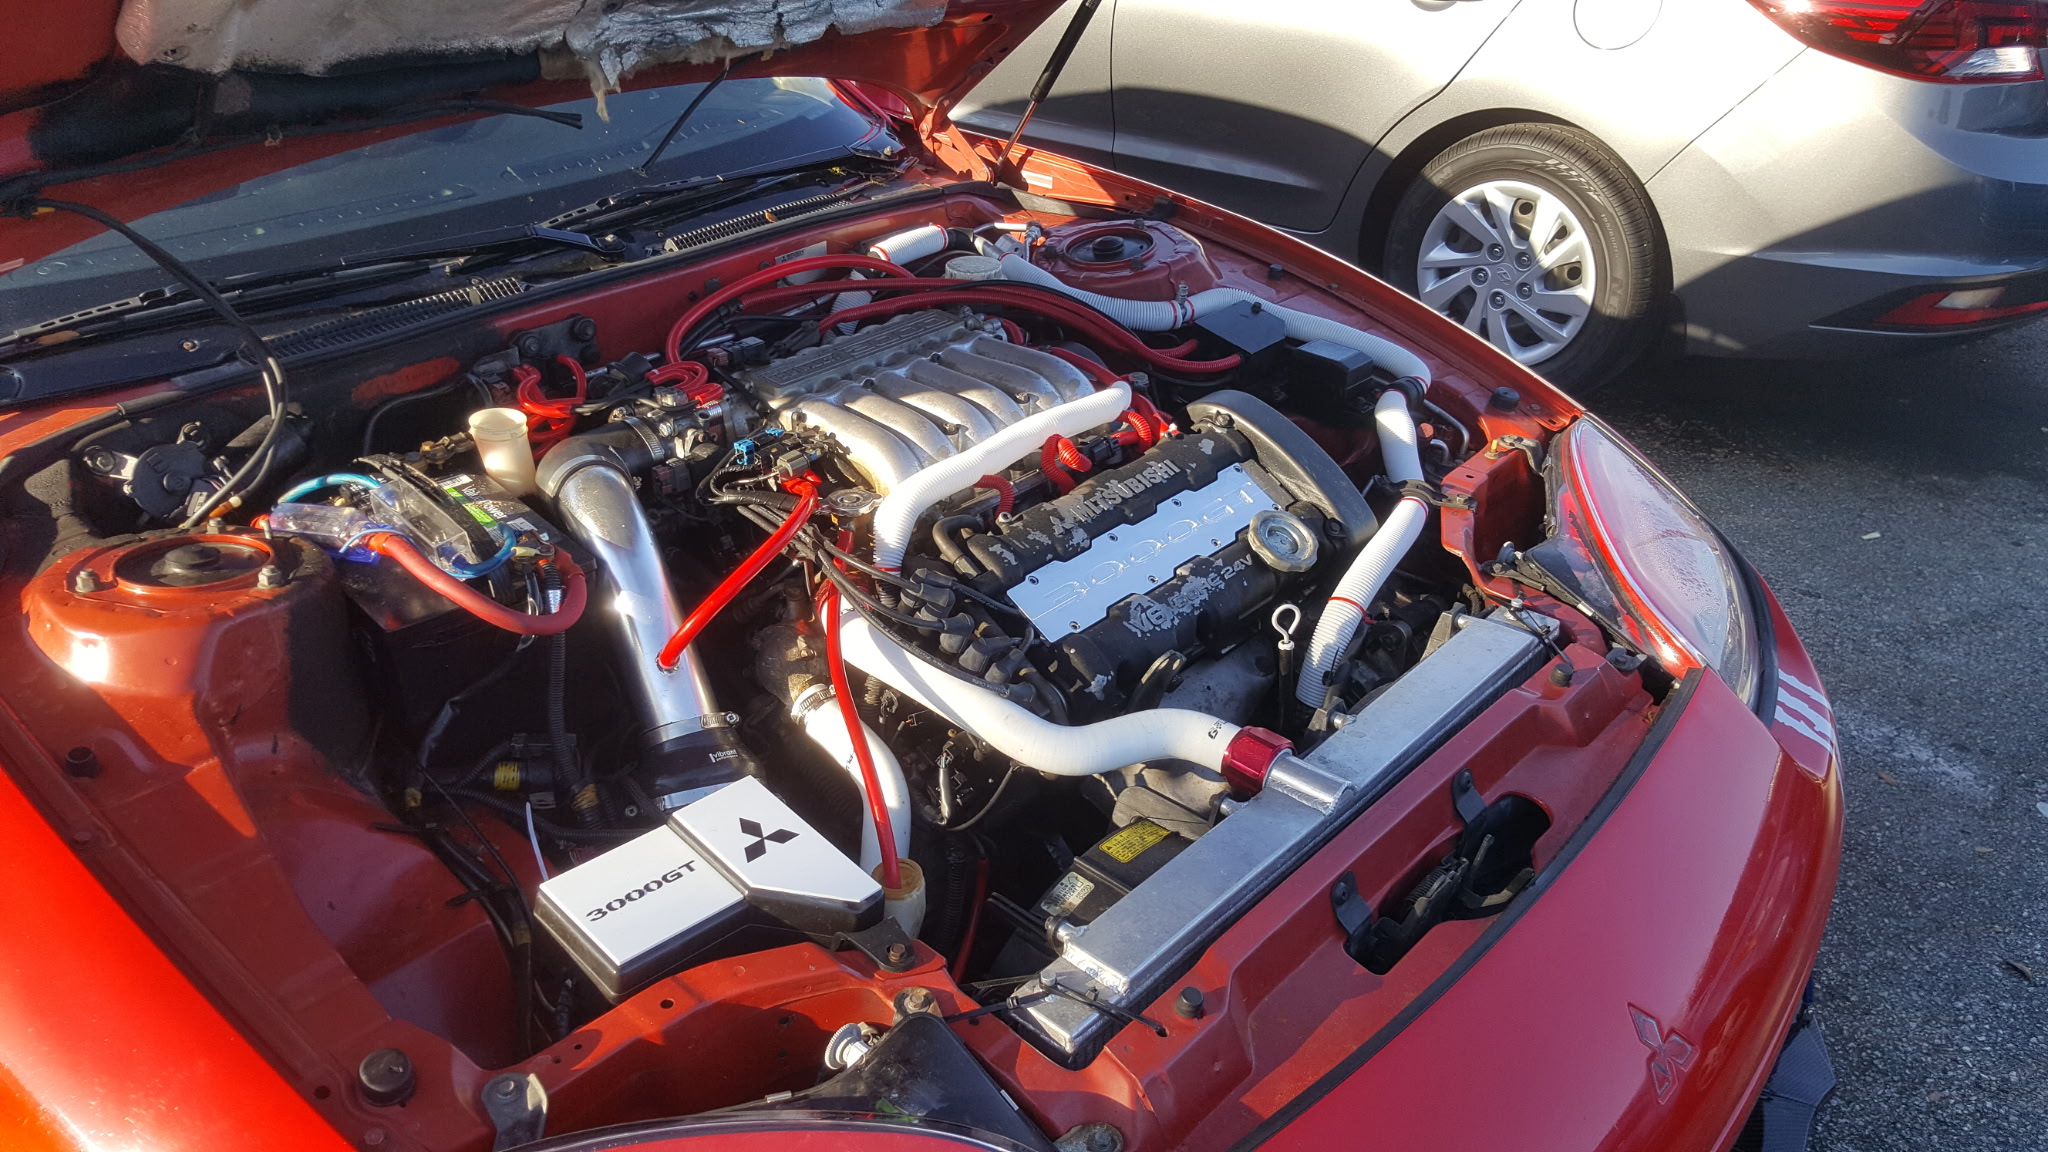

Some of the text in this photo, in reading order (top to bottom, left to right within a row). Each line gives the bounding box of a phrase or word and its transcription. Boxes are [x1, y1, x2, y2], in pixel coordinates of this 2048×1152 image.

[1069, 458, 1181, 523] MITSUBISHI
[1043, 481, 1254, 611] 3000GT
[1128, 606, 1168, 632] V6
[1221, 553, 1253, 580] 24V
[713, 749, 737, 759] vibrant
[585, 859, 696, 922] 3000GT
